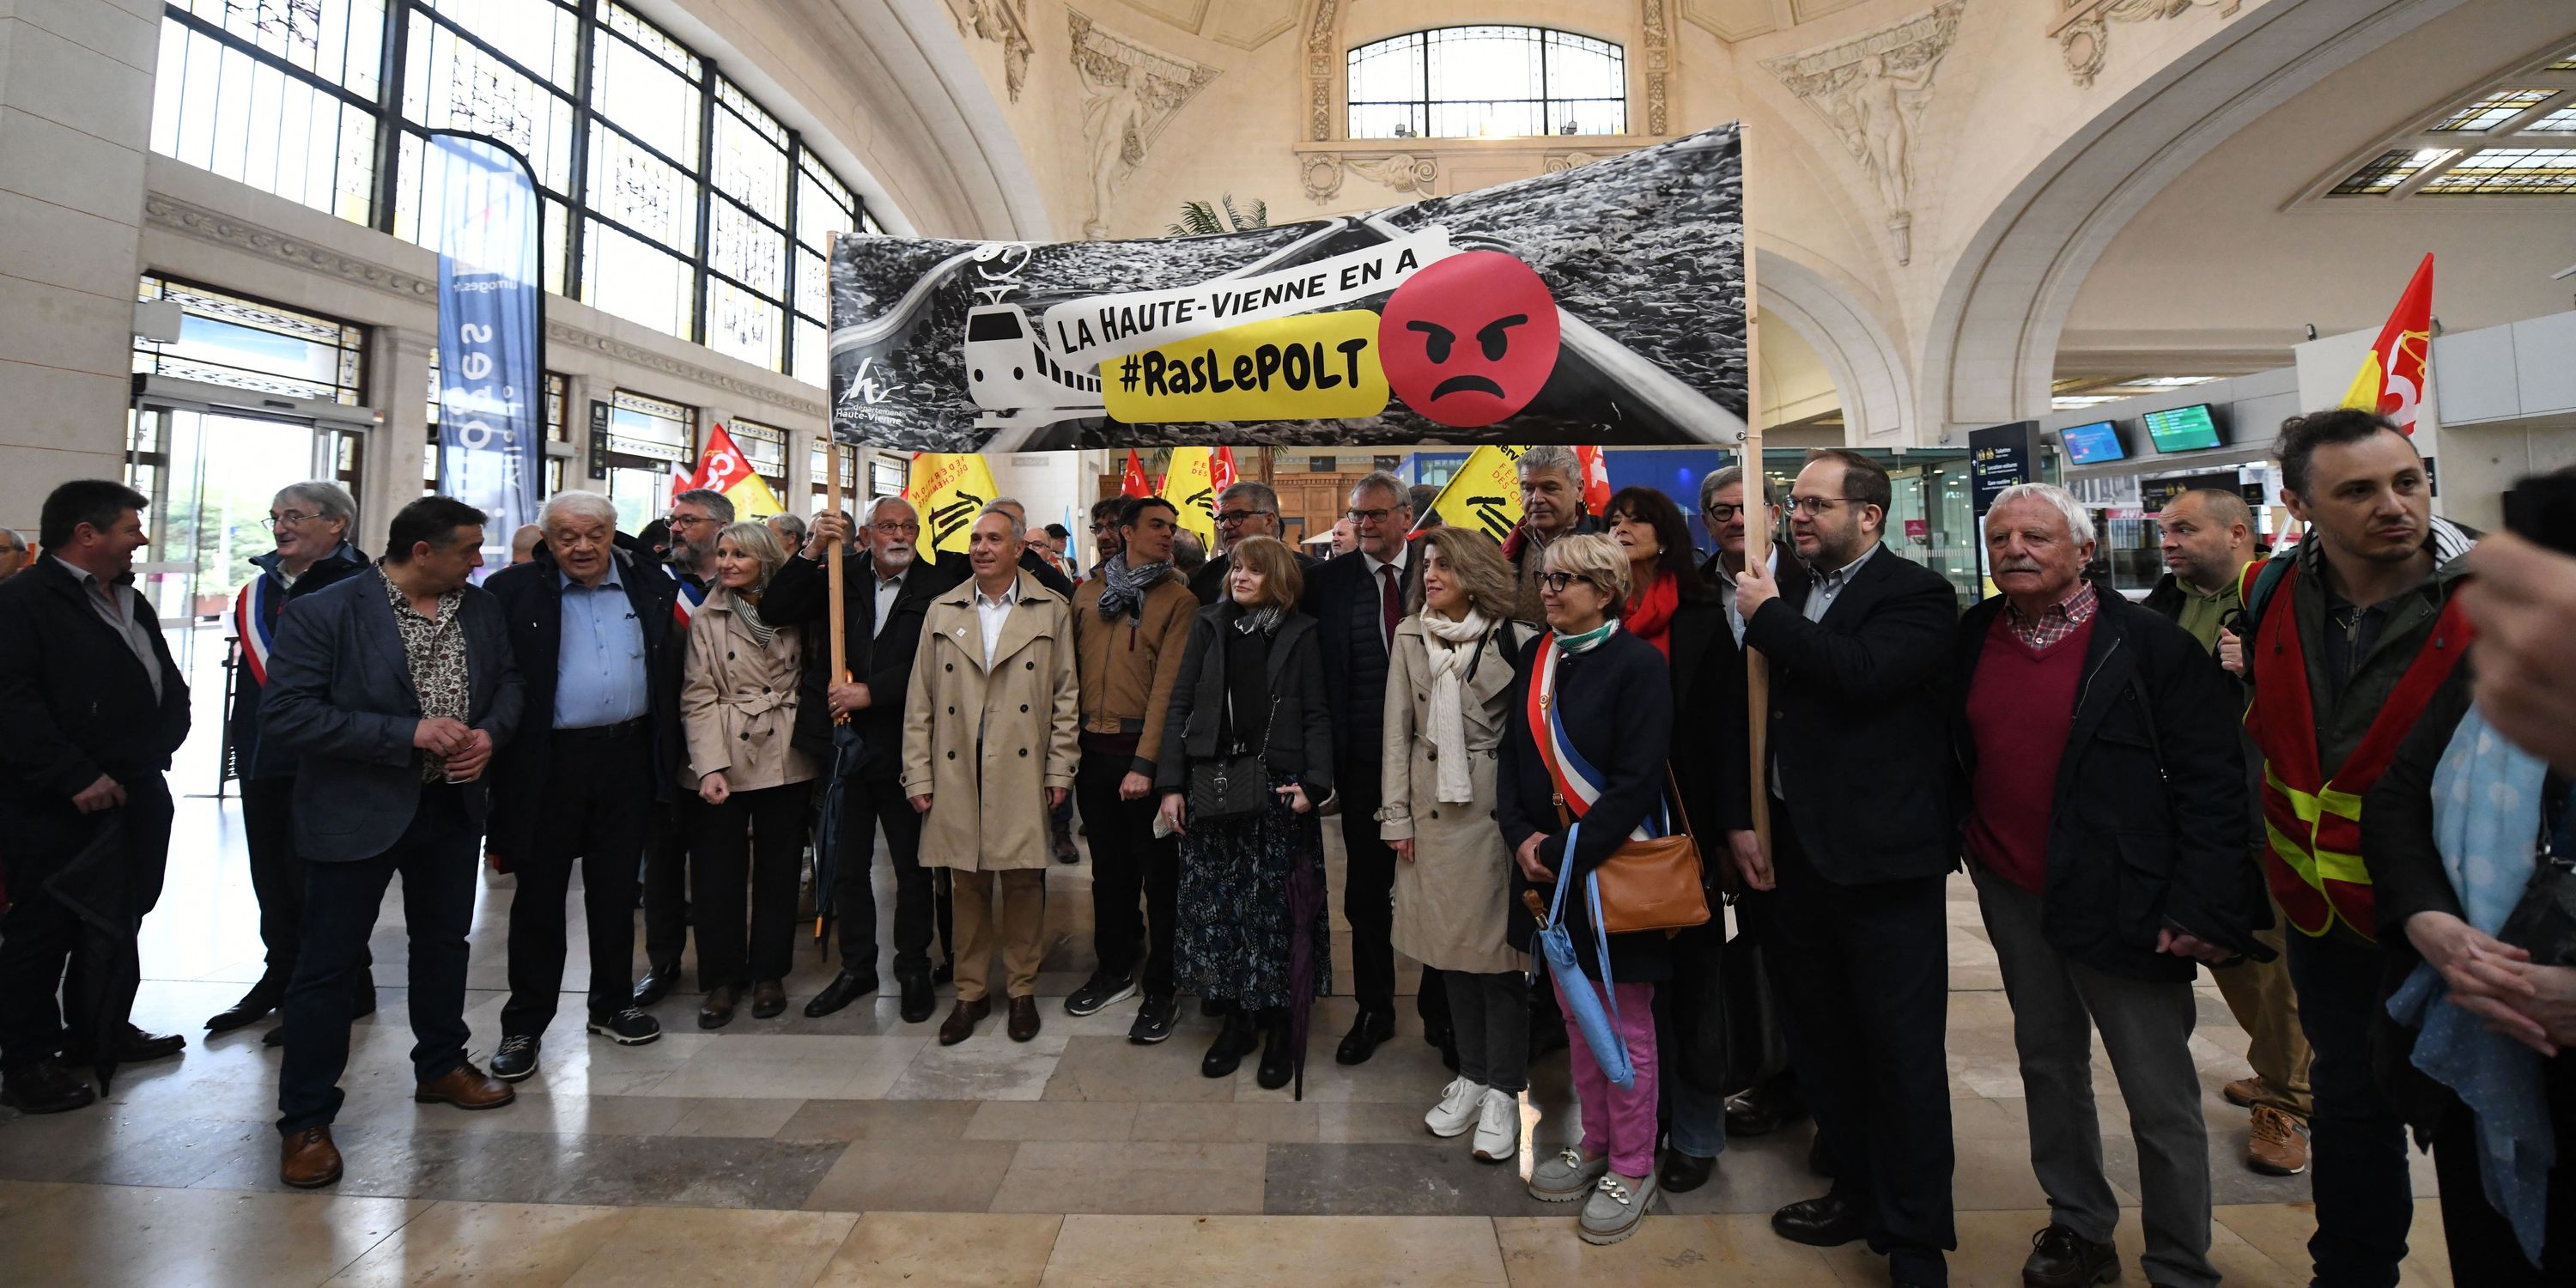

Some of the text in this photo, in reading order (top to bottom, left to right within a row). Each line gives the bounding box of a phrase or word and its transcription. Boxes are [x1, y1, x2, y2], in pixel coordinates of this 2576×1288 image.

[1057, 248, 1419, 355] LA HAUTE-VIENNE EN A
[1119, 337, 1368, 397] #RasLePOLT
[835, 409, 902, 425] Haute-Vienne
[1492, 470, 1510, 489] DES
